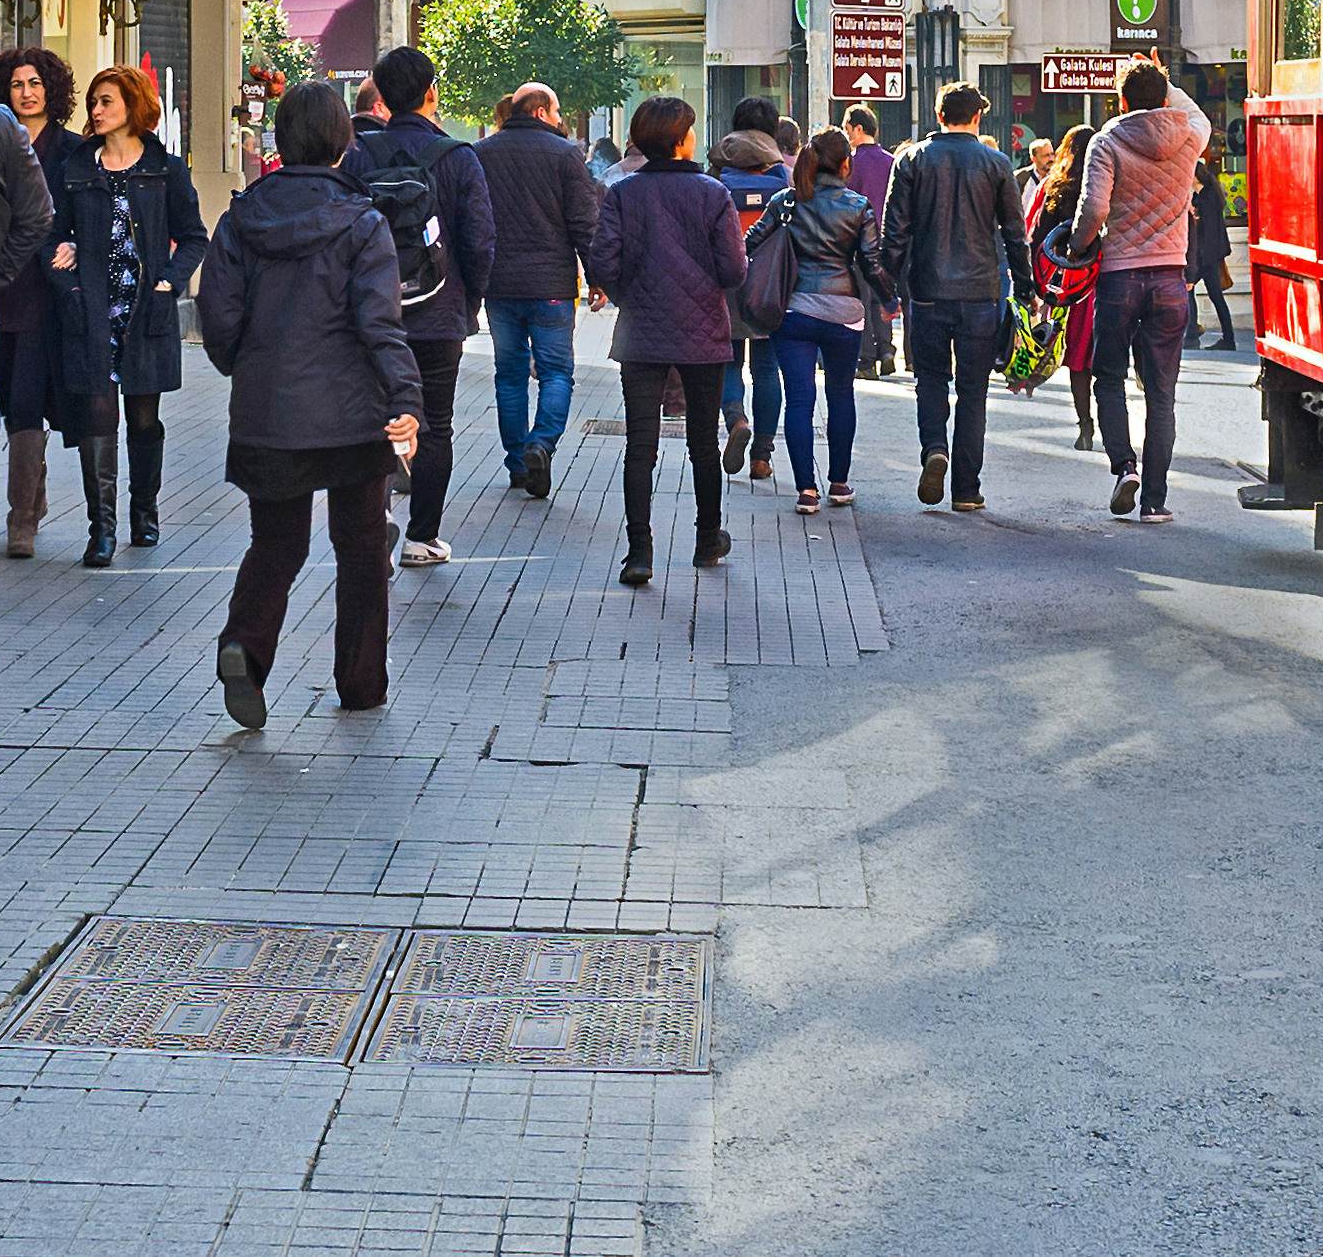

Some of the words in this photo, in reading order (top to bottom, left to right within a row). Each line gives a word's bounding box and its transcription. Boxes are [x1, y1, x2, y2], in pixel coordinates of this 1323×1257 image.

[1060, 58, 1088, 72] Galata
[1088, 58, 1114, 72] Kulesi
[1059, 74, 1088, 88] (Galata
[1090, 74, 1116, 89] Tower)
